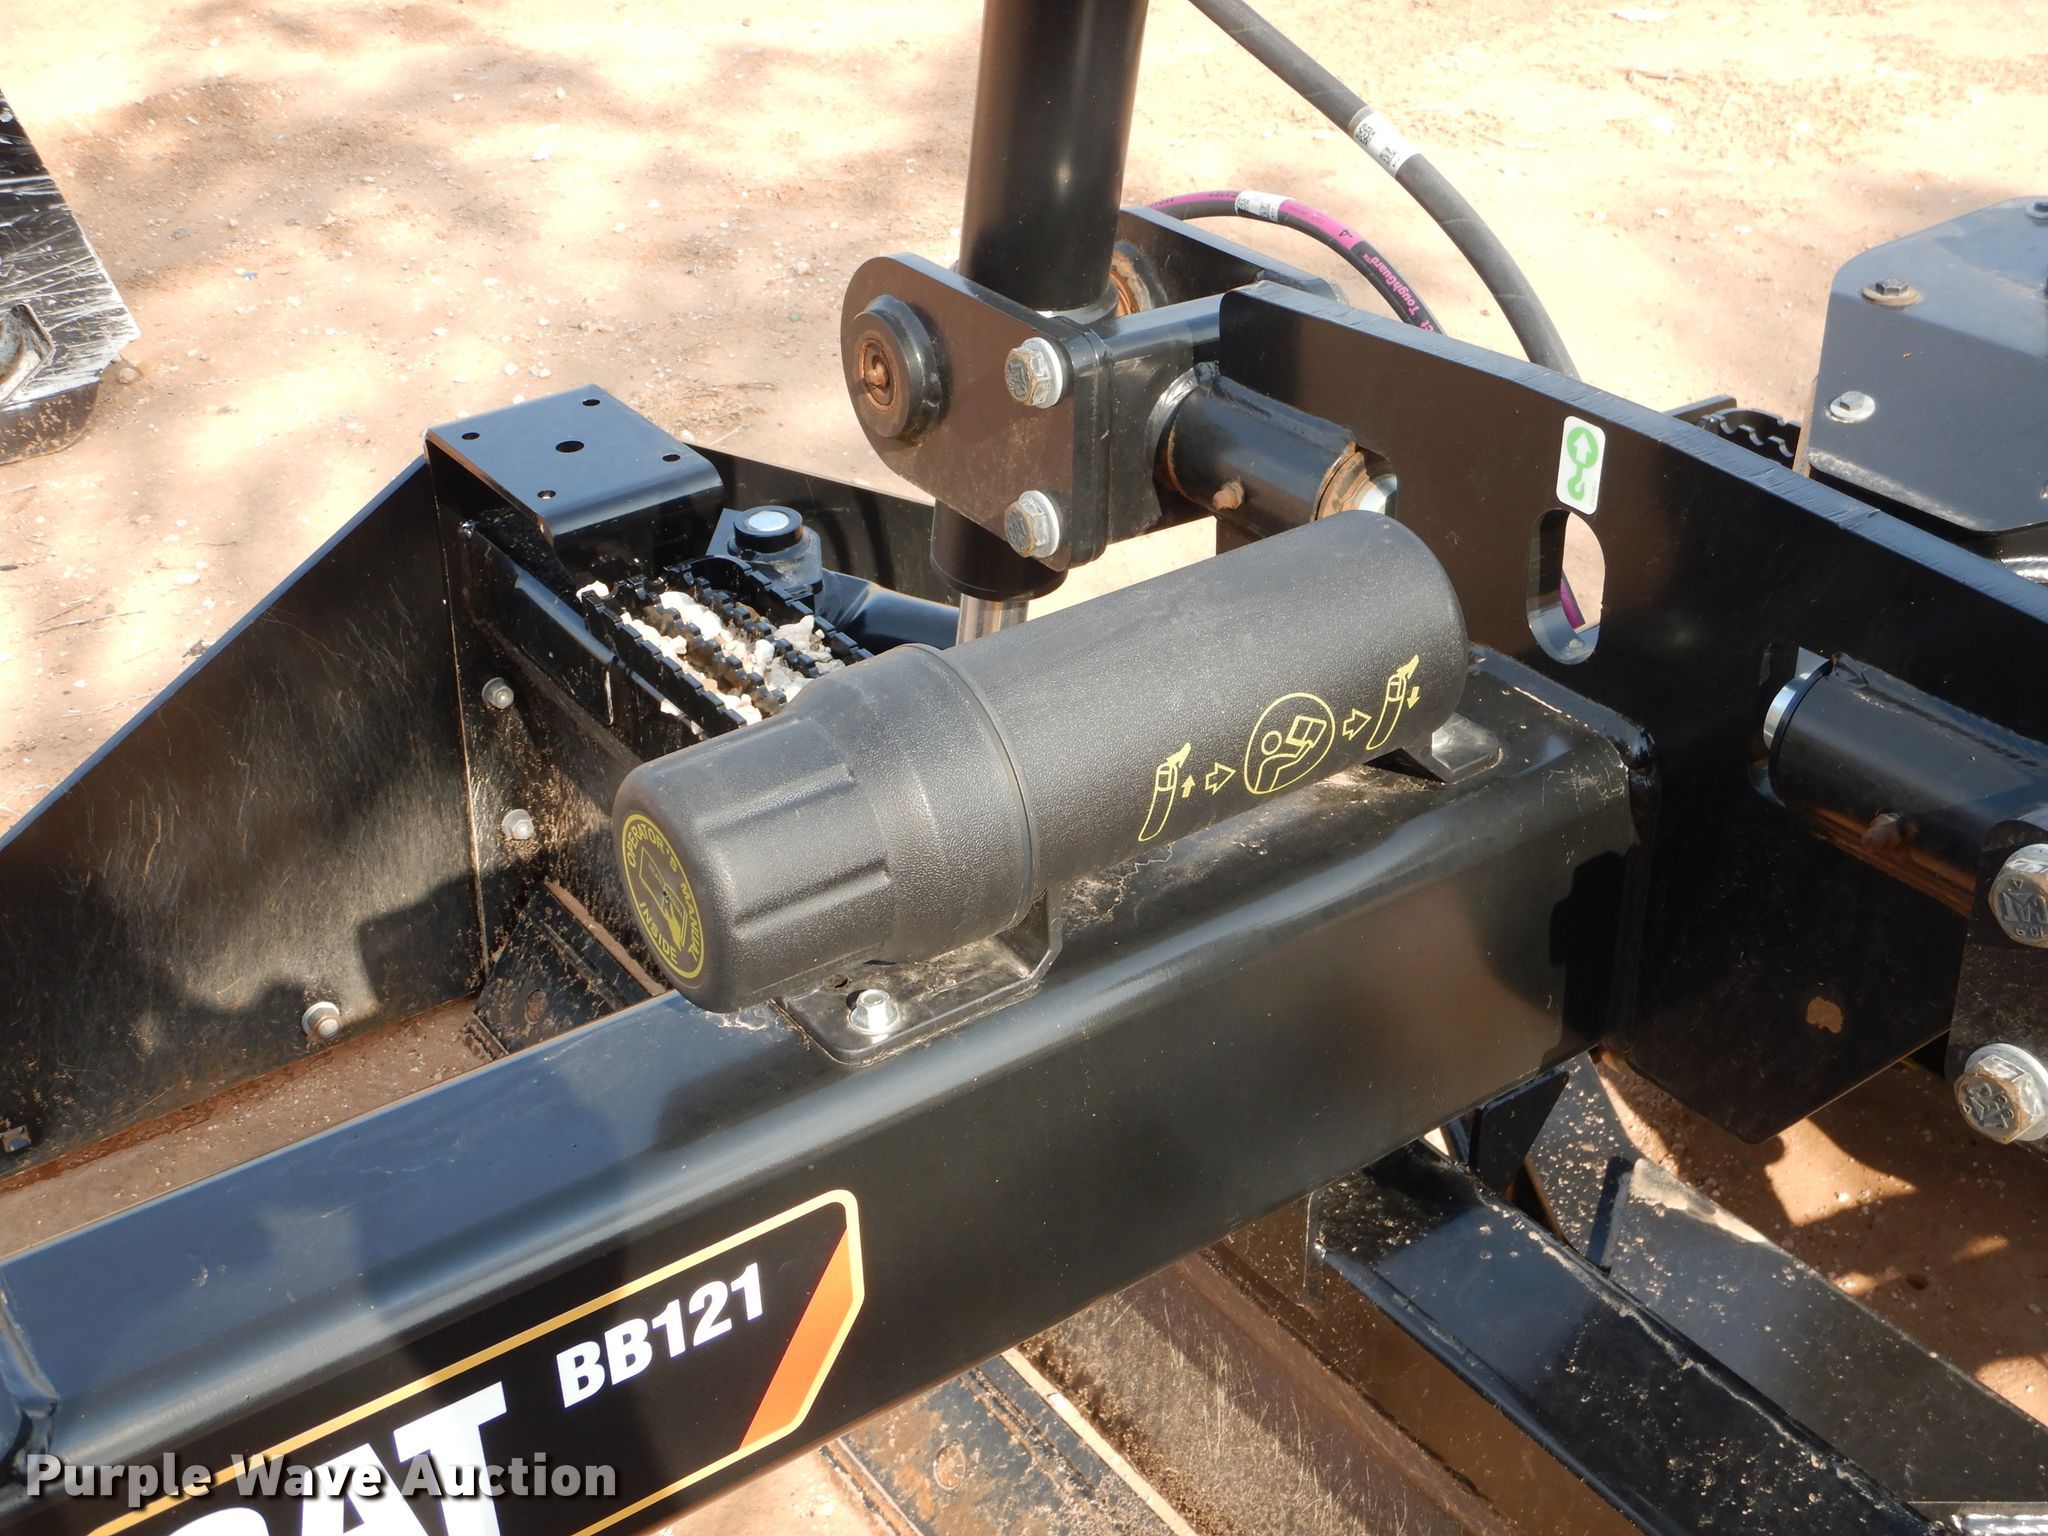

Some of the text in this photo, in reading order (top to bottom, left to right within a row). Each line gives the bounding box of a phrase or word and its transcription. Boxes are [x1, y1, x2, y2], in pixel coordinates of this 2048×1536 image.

[626, 823, 677, 872] OPERATOR'S
[680, 882, 700, 962] MANUAL
[639, 902, 679, 965] INSIDE
[556, 1262, 763, 1408] BB121
[168, 1381, 508, 1536] AT
